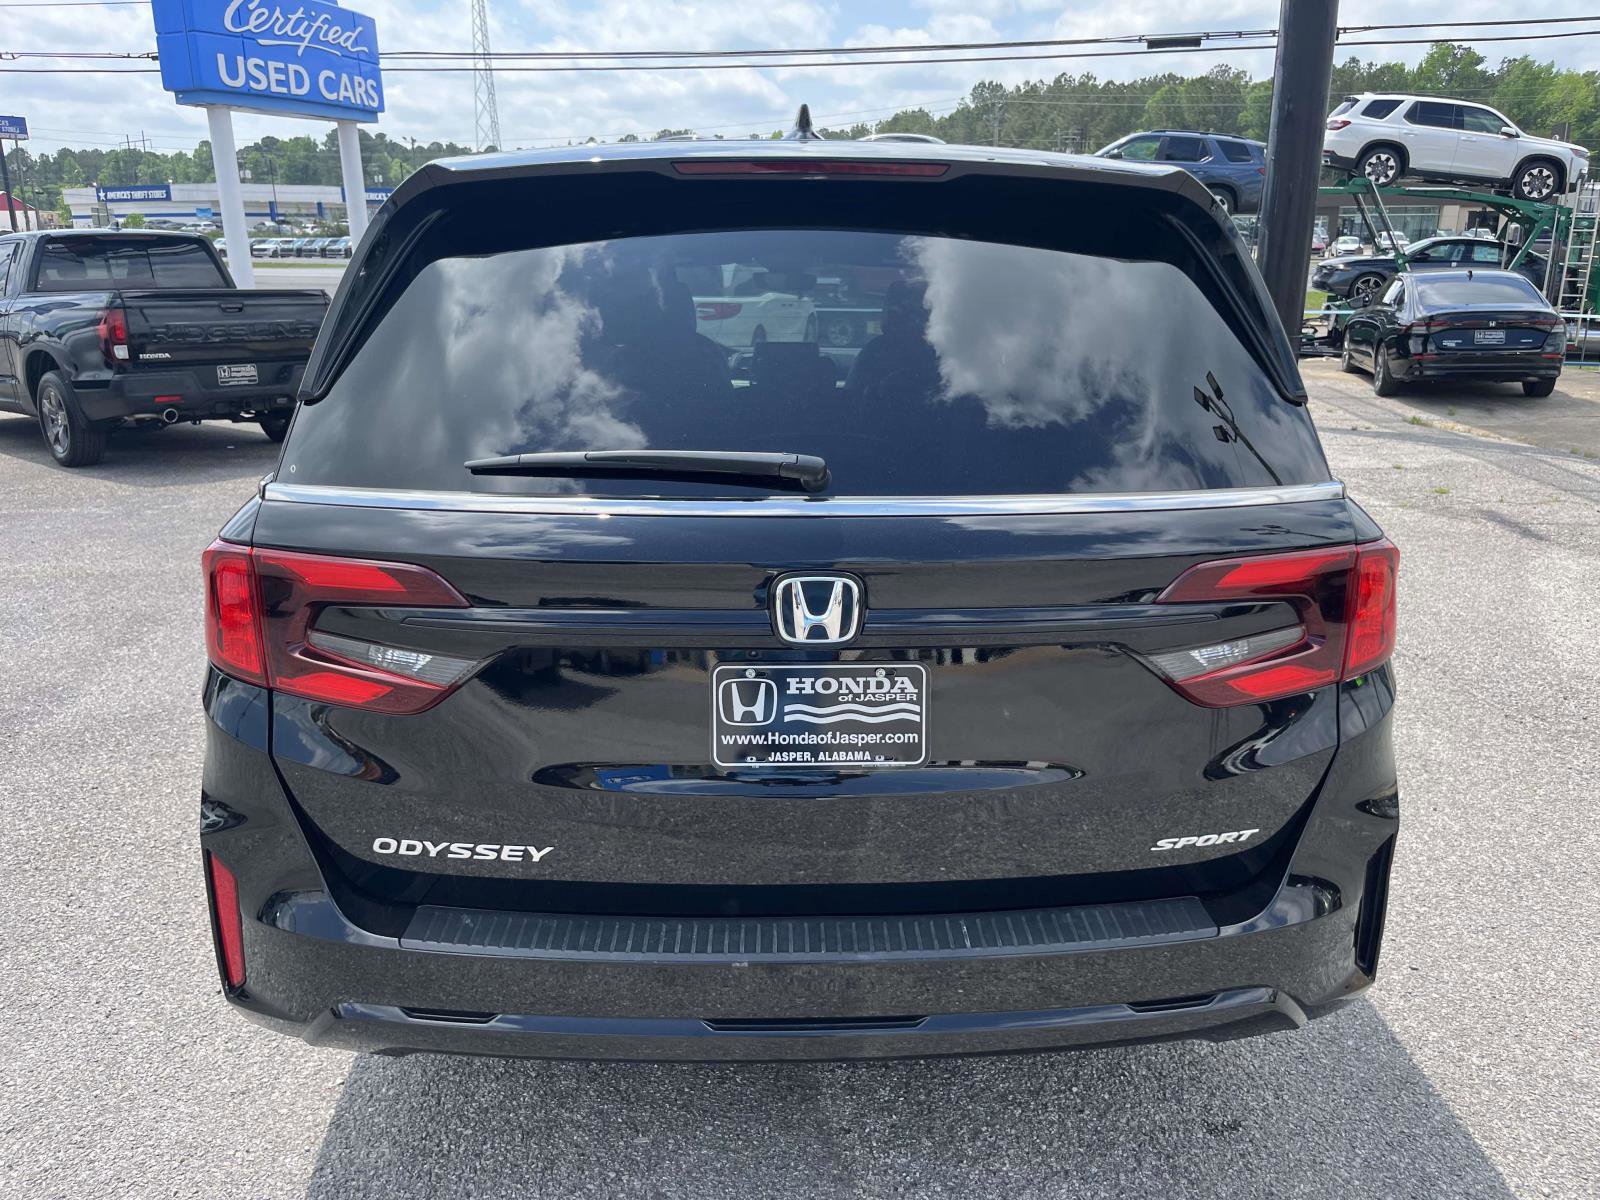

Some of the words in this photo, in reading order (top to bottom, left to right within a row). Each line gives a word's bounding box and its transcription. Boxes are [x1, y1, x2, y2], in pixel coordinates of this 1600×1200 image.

[223, 0, 369, 57] Certified
[216, 53, 310, 96] USED
[318, 69, 380, 108] CARS
[131, 190, 148, 199] THRIFT
[148, 189, 167, 199] STORES
[139, 352, 172, 360] HONDA
[786, 676, 918, 695] HONDA
[838, 693, 854, 702] of
[856, 693, 917, 702] JASPER
[721, 731, 919, 747] www.HondaofJasper.com
[768, 751, 815, 763] JASPER,
[818, 751, 872, 762] ALABAMA
[1150, 828, 1260, 851] SPORT
[372, 837, 555, 863] ODYSSEY
